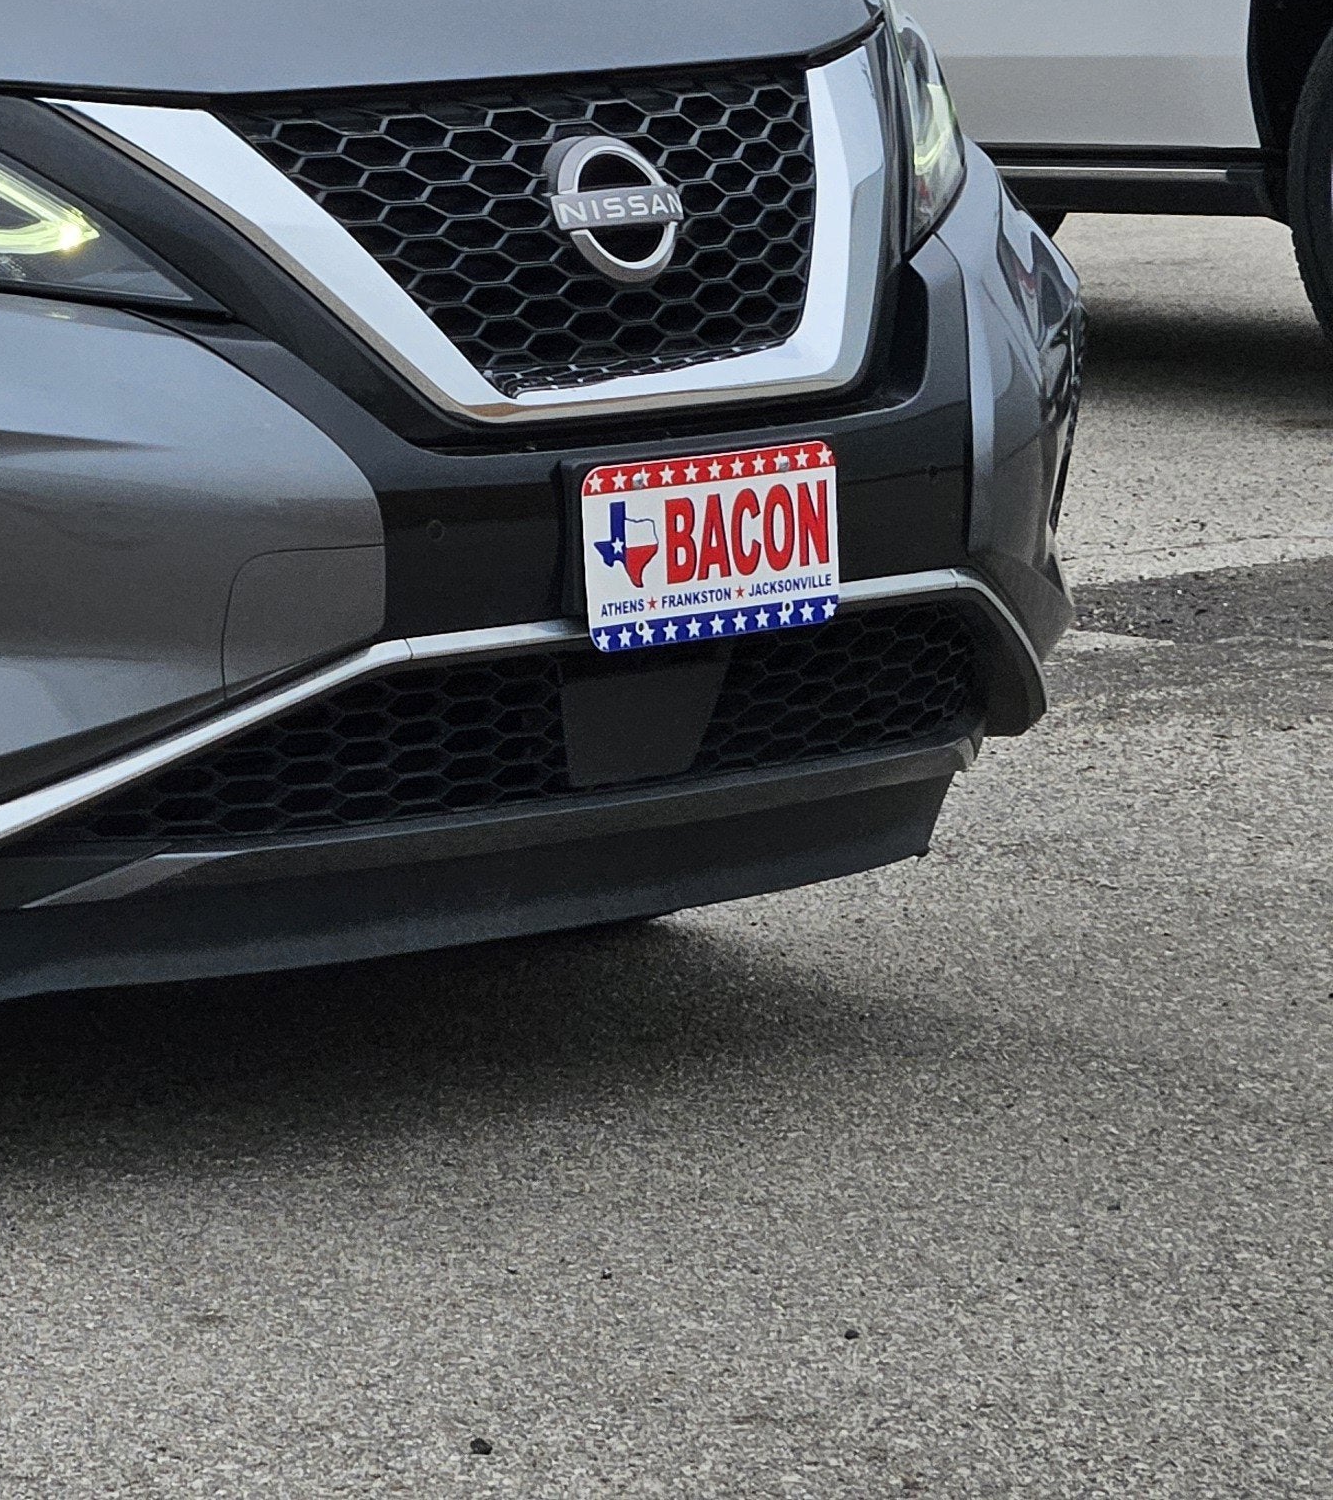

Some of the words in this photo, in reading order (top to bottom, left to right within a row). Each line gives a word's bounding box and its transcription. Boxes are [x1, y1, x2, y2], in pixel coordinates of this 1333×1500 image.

[558, 193, 683, 224] NISSAN
[664, 479, 830, 585] BACON
[601, 598, 645, 618] ATHENS
[661, 588, 732, 609] FRANKSTON
[748, 573, 832, 597] JACKSONVILLE
